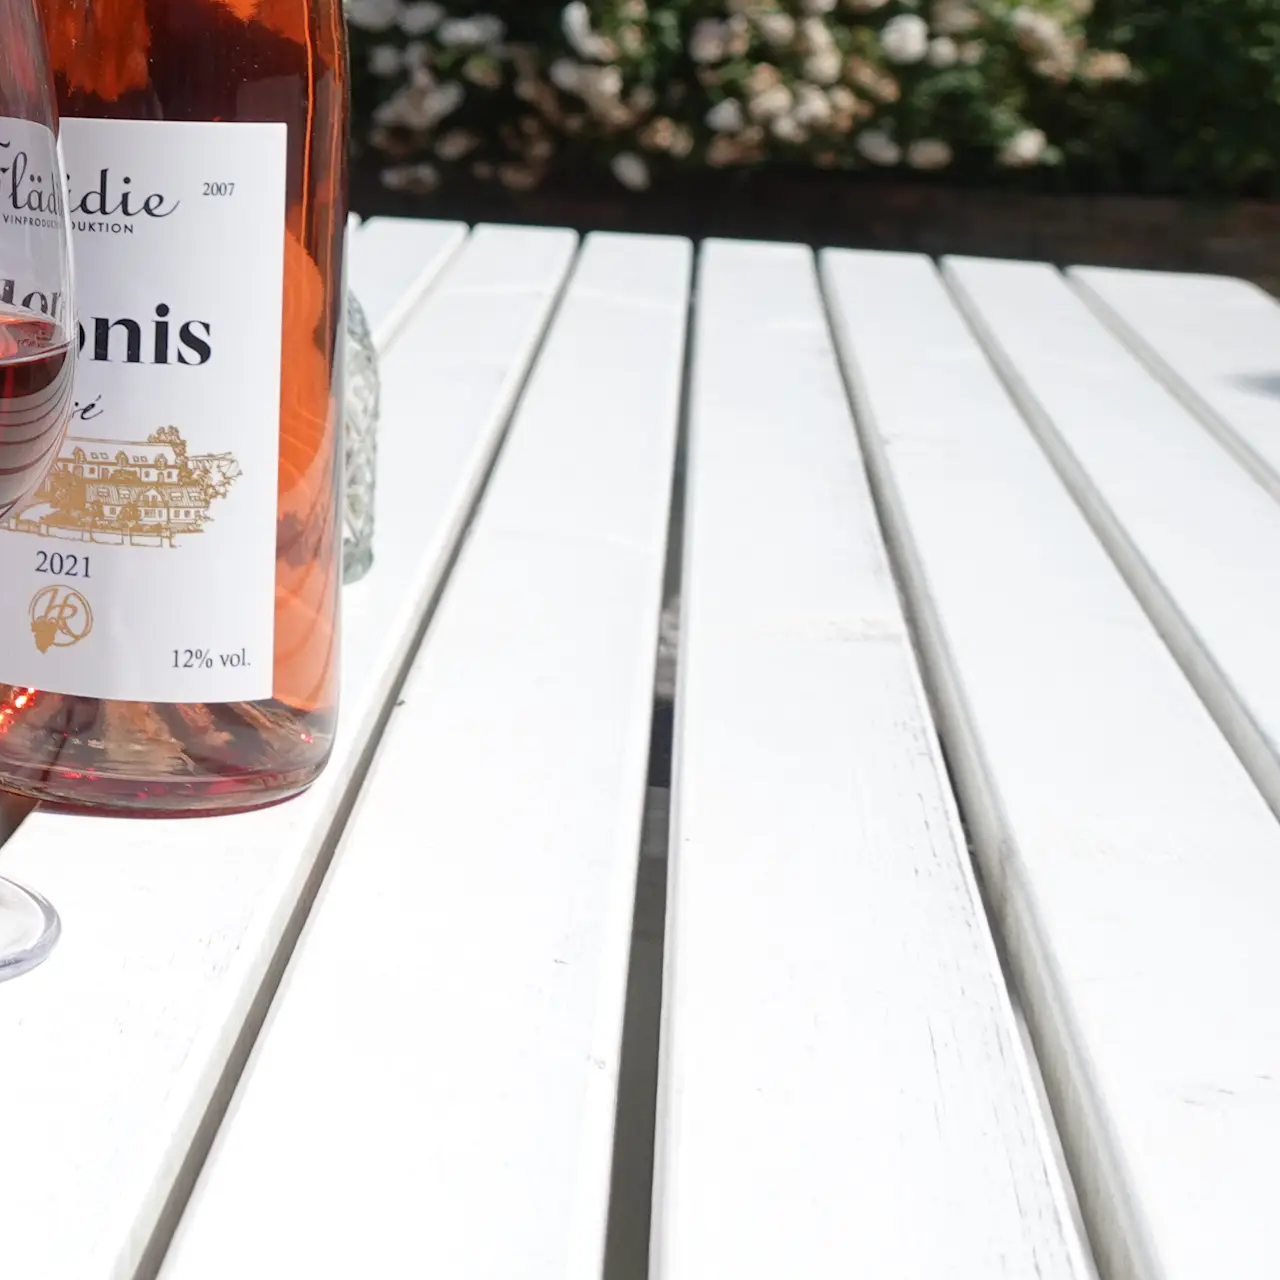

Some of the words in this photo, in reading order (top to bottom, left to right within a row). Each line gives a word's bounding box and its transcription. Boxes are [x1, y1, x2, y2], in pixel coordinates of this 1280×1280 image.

[202, 181, 236, 198] 2007
[34, 550, 92, 579] 2021
[171, 648, 214, 670] 12%
[218, 647, 252, 669] vol.
